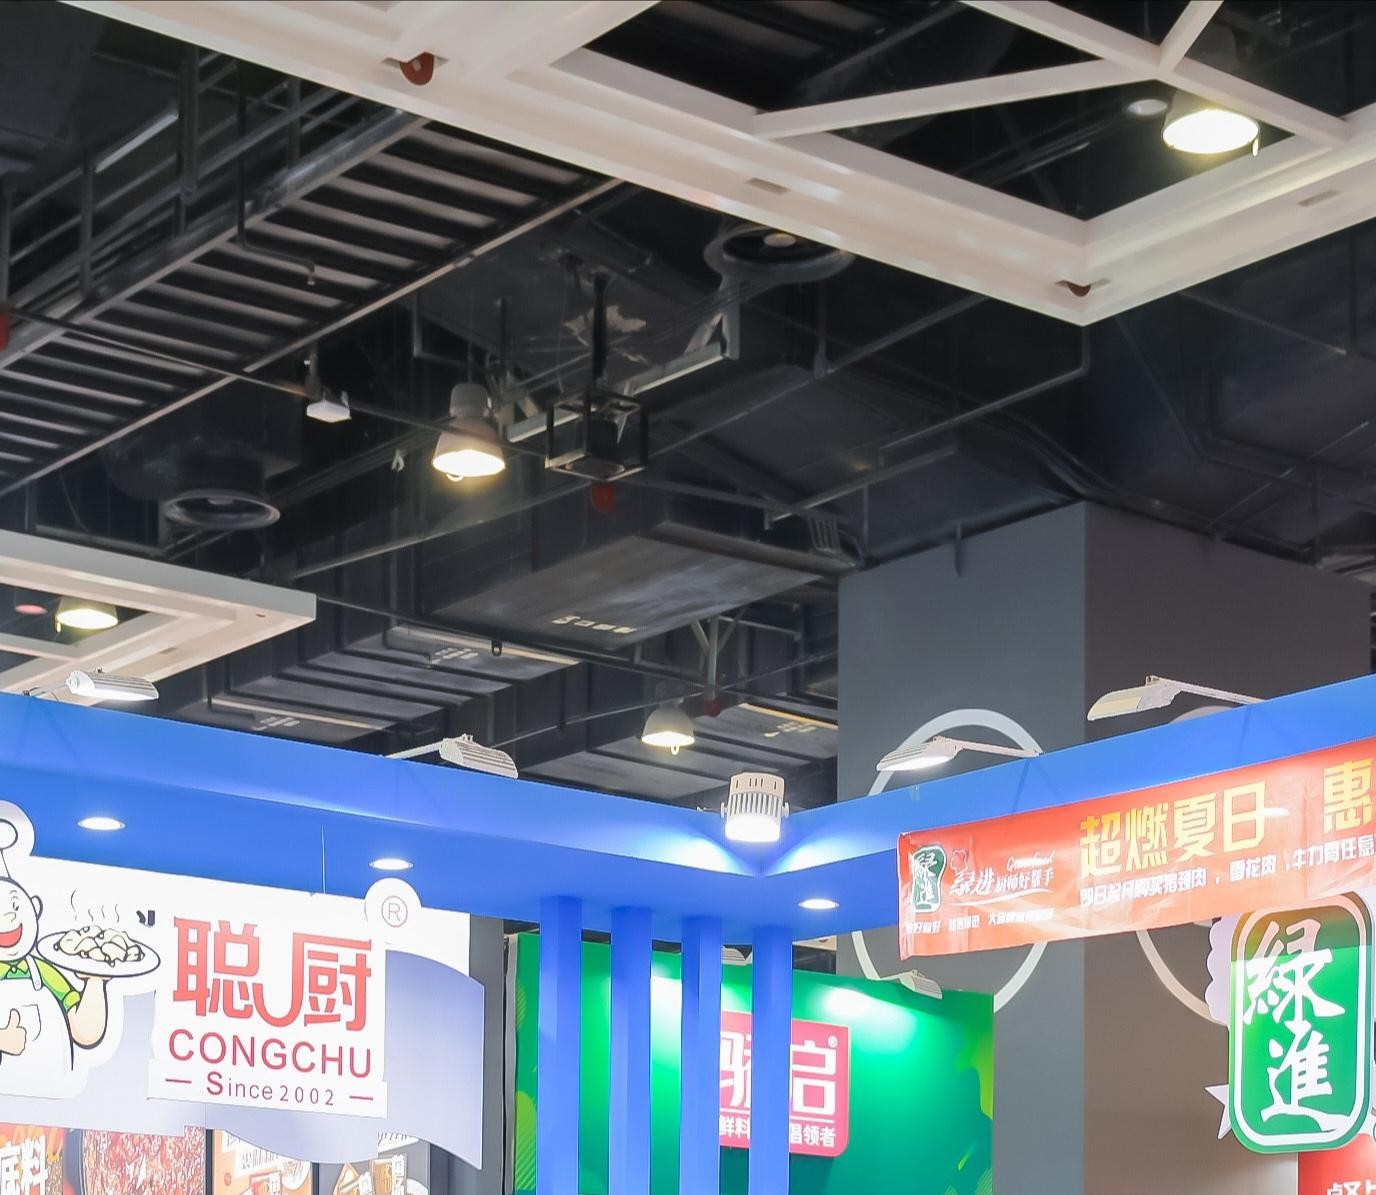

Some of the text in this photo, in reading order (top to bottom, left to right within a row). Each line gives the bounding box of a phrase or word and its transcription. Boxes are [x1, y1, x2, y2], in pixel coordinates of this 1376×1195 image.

[1079, 781, 1267, 879] 超燃夏日
[172, 916, 373, 1033] 聪厨
[169, 1029, 372, 1079] CONGCHU
